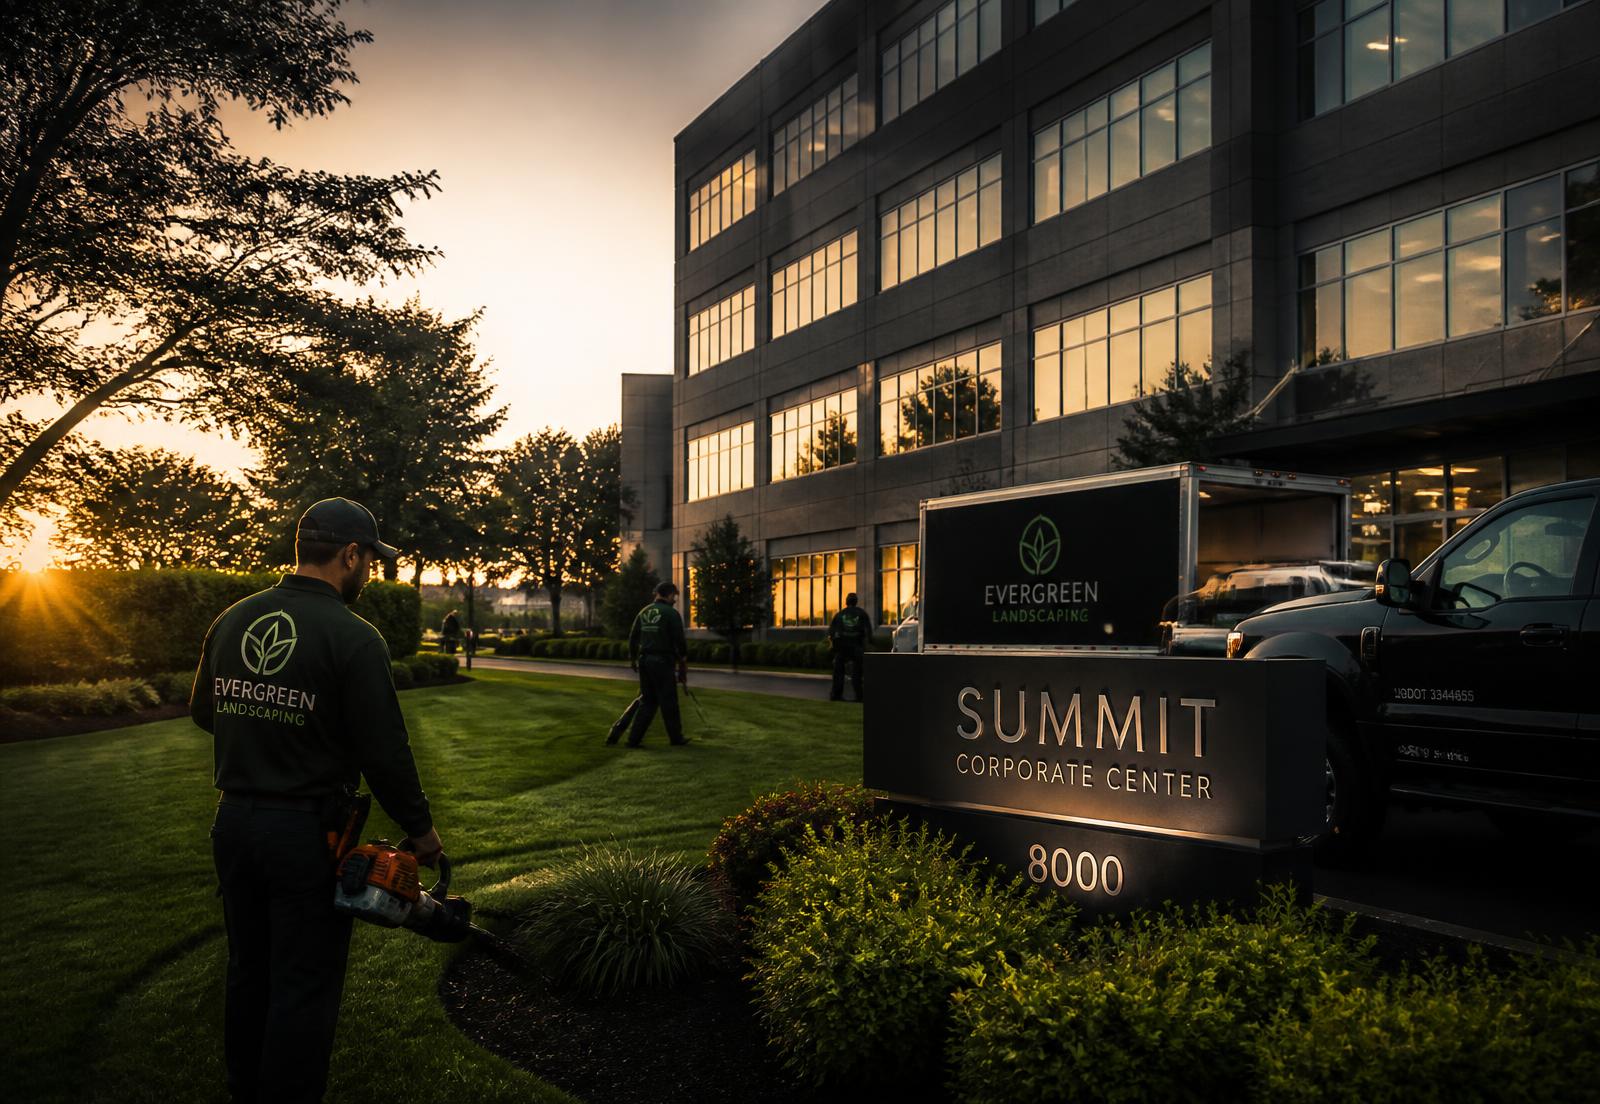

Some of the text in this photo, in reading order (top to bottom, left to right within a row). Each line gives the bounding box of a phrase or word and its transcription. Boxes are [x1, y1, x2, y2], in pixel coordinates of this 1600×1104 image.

[984, 581, 1099, 605] EVERGREEN
[992, 608, 1089, 623] LANDSCAPING
[214, 677, 316, 711] EVERGREEN
[216, 701, 305, 726] LANDSCAPING
[956, 686, 1217, 758] SUMMIT
[956, 753, 1213, 800] CORPORATE CENTER
[1027, 843, 1125, 897] 8000
